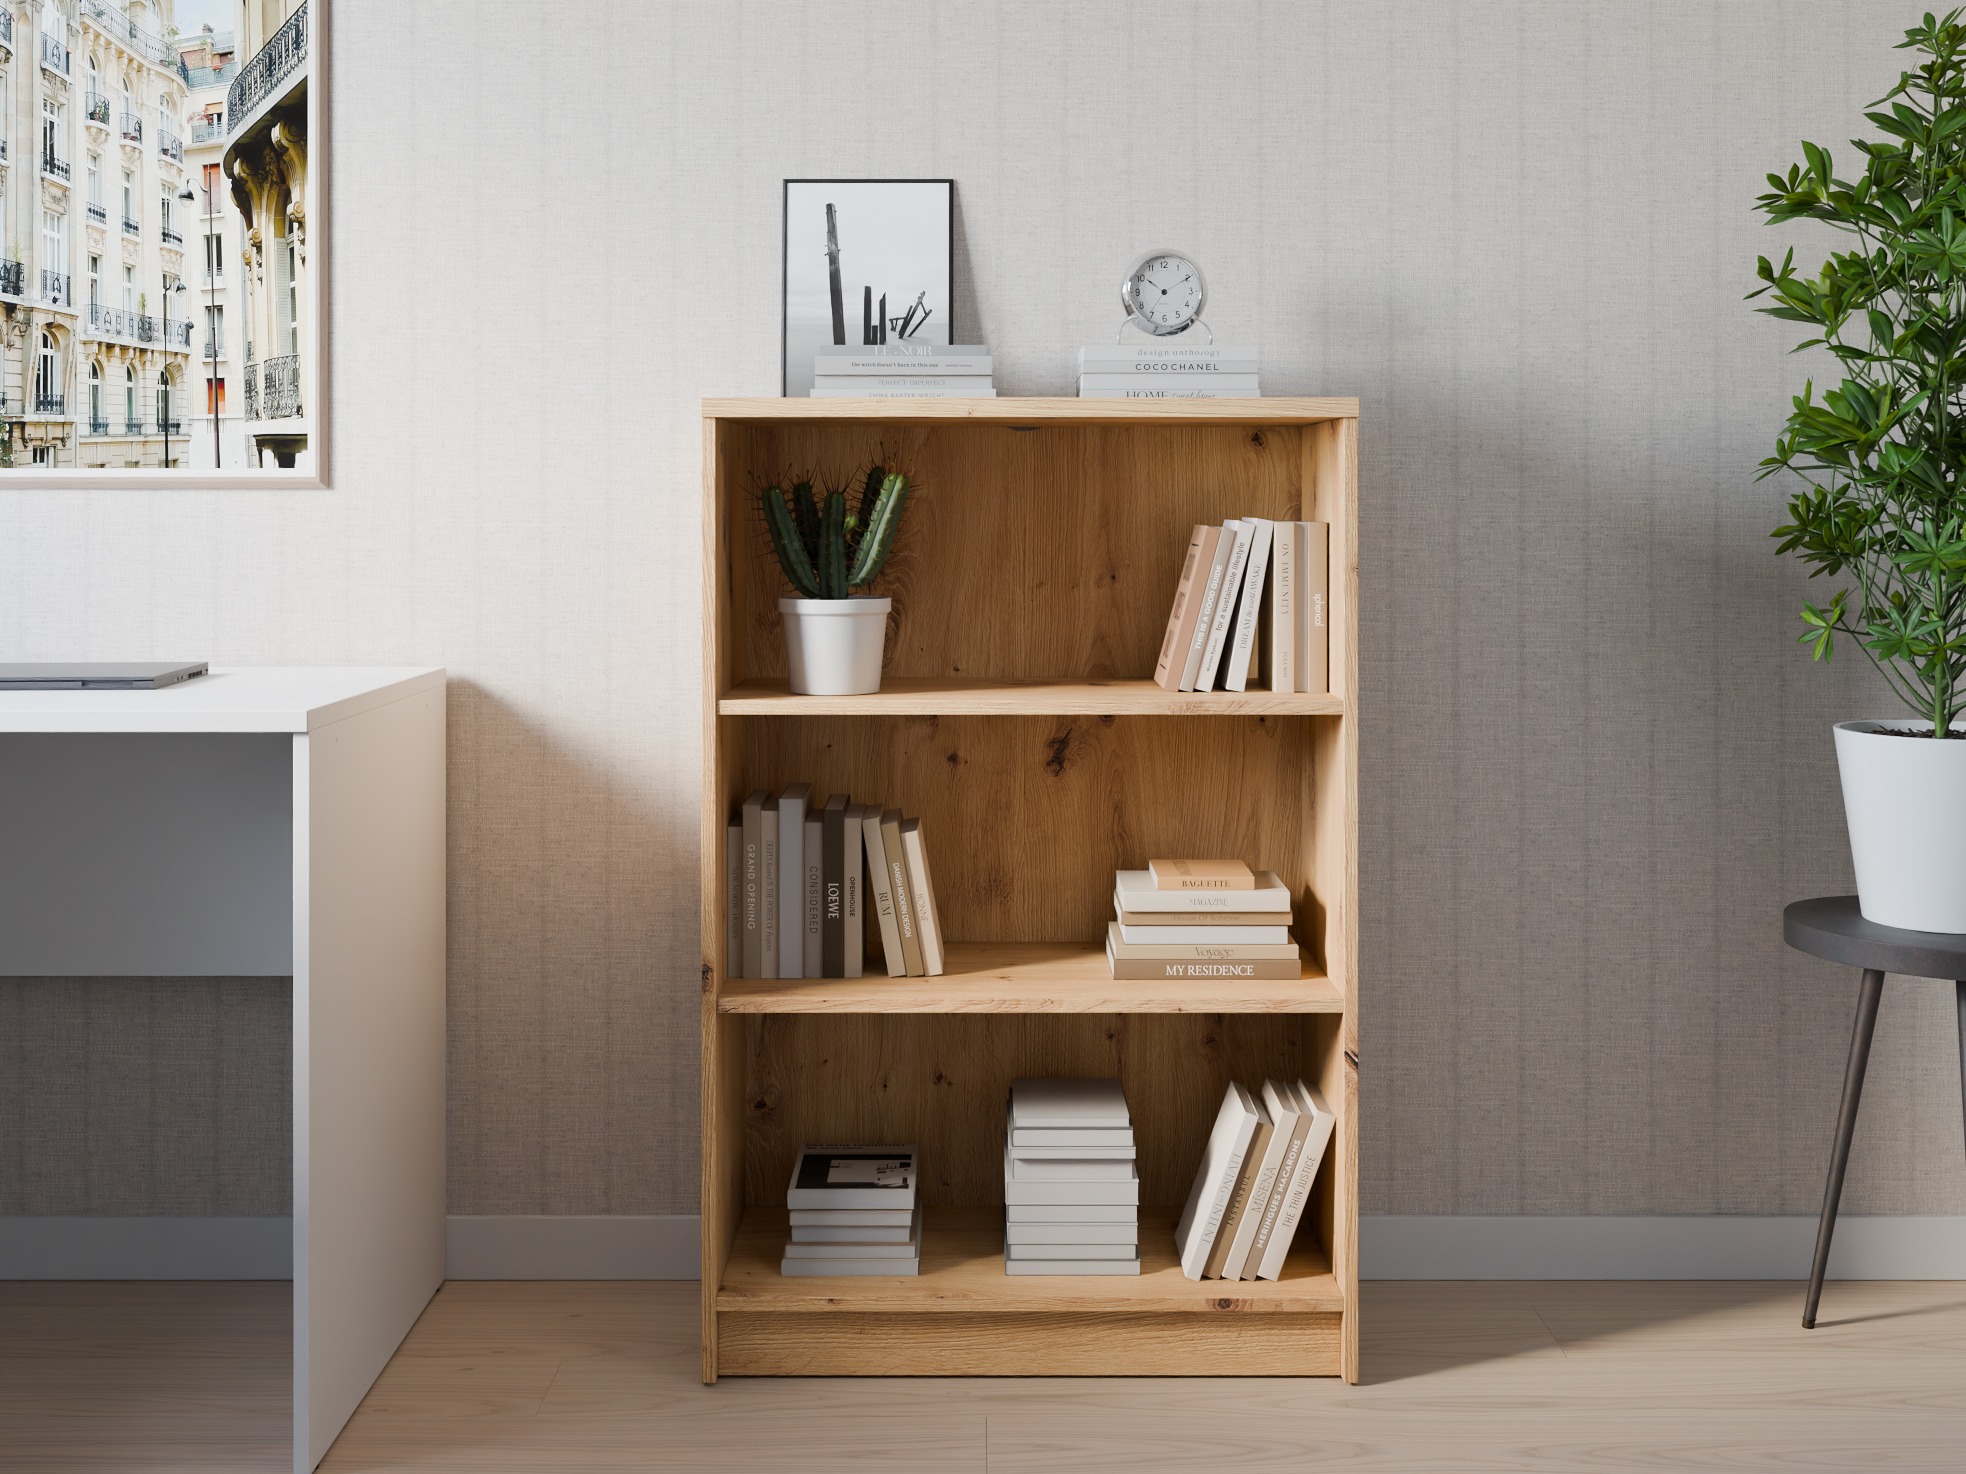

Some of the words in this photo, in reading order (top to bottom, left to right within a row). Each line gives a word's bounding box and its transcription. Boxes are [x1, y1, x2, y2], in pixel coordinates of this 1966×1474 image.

[1137, 274, 1145, 282] 10
[1185, 274, 1191, 282] 2
[1135, 288, 1140, 296] 9
[1189, 287, 1193, 295] 3
[1150, 311, 1154, 319] 7
[874, 346, 890, 355] LE
[900, 346, 932, 355] NOIR
[1137, 349, 1169, 357] design
[1173, 349, 1221, 357] anthology
[1282, 544, 1288, 556] ON
[1216, 620, 1224, 631] for
[1222, 571, 1237, 613] sustainable
[1232, 542, 1244, 570] lifestyle
[1195, 631, 1204, 650] THIS
[1201, 622, 1207, 631] IS
[1205, 591, 1215, 615] GOOD
[1212, 565, 1222, 589] GUIDE
[1240, 619, 1251, 649] DREAM
[1250, 563, 1262, 593] AWAKE
[893, 863, 902, 886] DANISH
[809, 866, 818, 934] CONSIDERED
[828, 883, 839, 919] LOEWE
[879, 892, 891, 915] RUM
[898, 887, 907, 914] MODERN
[767, 923, 773, 932] OF
[902, 915, 912, 937] DESIGN
[1195, 947, 1235, 958] Voyage
[1166, 965, 1184, 976] MY
[1188, 965, 1254, 976] RESIDENCE
[1224, 1153, 1241, 1194] LIVING
[1227, 1175, 1250, 1225] INSTANBUL
[1256, 1194, 1281, 1248] MERINGUES
[1278, 1139, 1301, 1192] MACARONS
[1283, 1212, 1295, 1228] THE
[1289, 1191, 1303, 1209] THIN
[1300, 1155, 1316, 1189] JUSTICE
[1203, 1204, 1223, 1244] INTENT
